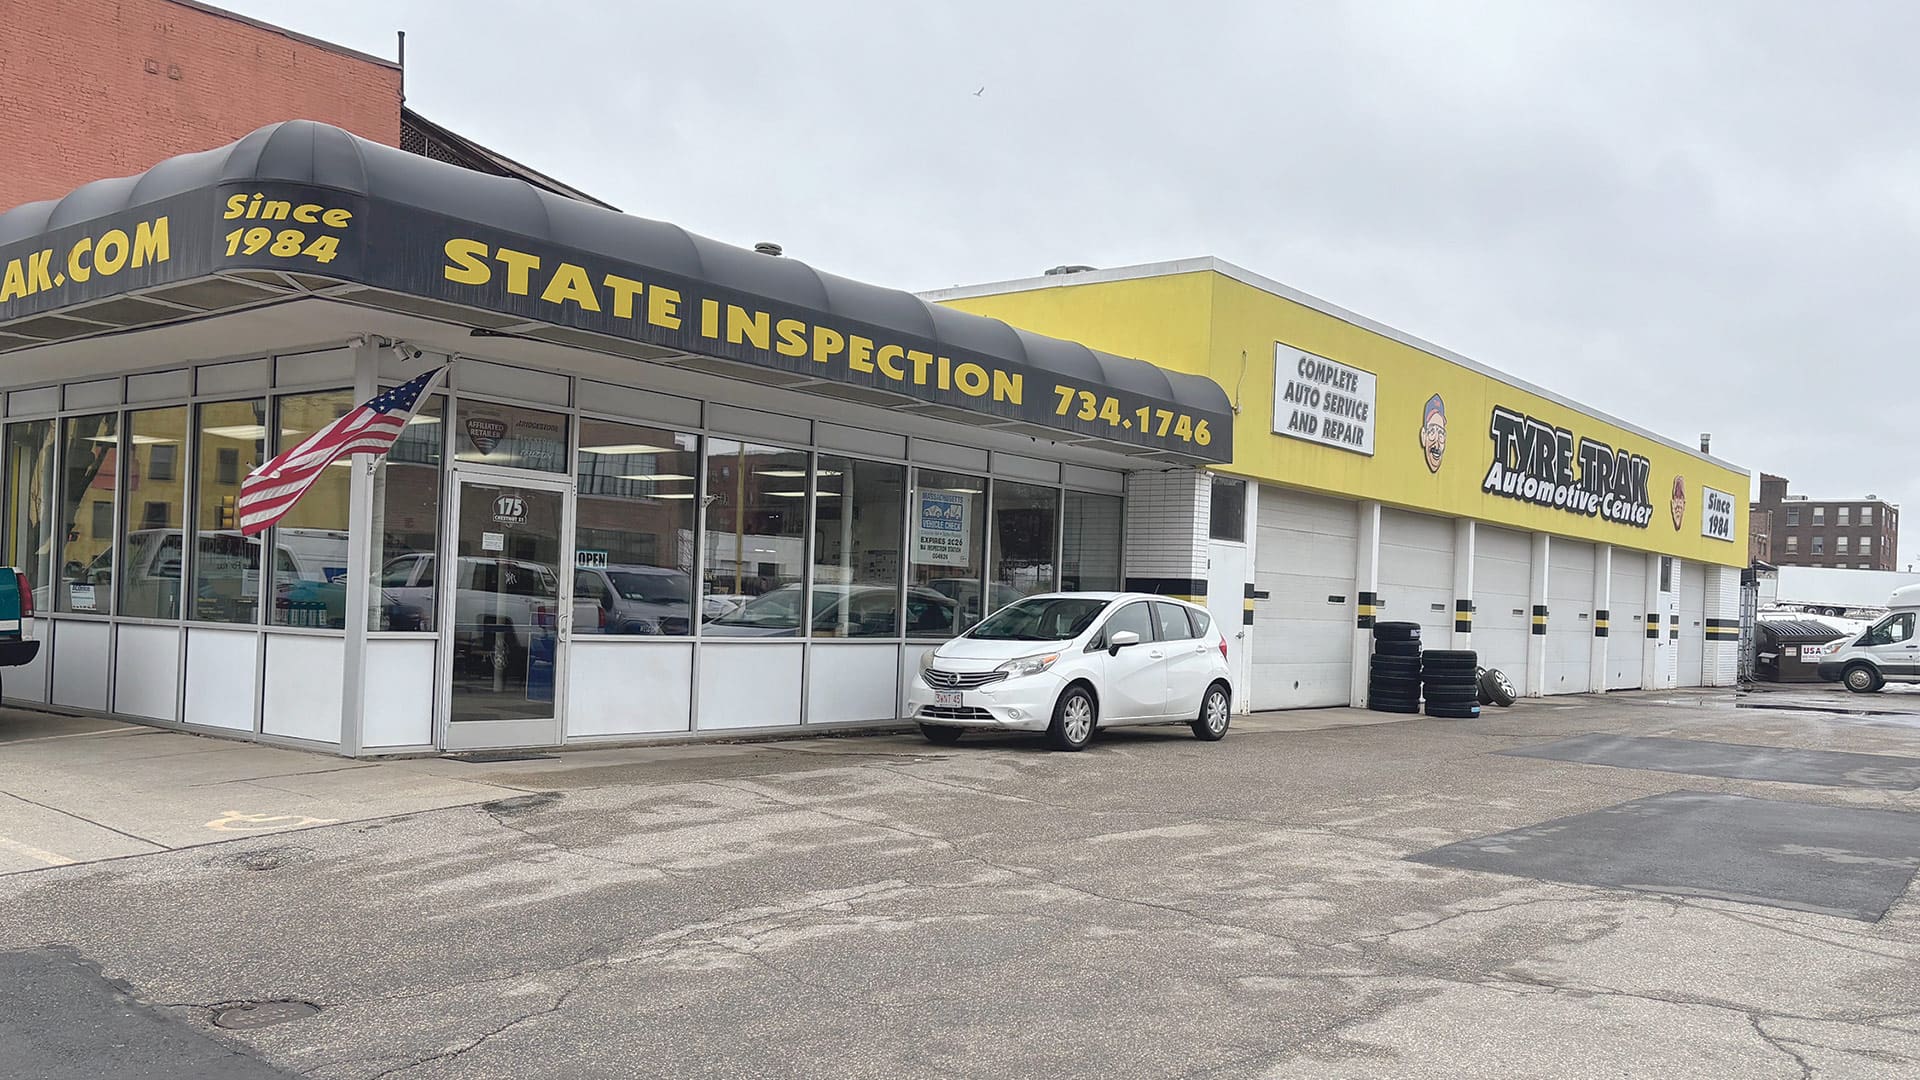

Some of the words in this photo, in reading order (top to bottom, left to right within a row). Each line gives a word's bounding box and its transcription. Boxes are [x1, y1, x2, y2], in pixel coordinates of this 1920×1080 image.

[223, 193, 353, 228] Since
[225, 226, 341, 264] 1984
[443, 237, 682, 330] STATE
[701, 300, 1024, 406] INSPECTION
[1054, 384, 1212, 446] 734.1746
[1297, 357, 1359, 393] COMPLETE
[1283, 380, 1320, 408] AUTO
[1322, 390, 1369, 422] SERVICE
[468, 421, 504, 431] AFFILIATED
[470, 429, 502, 438] RETAILER
[1288, 409, 1318, 434] AND
[1321, 417, 1364, 446] REPAIR
[1490, 406, 1574, 487] TYRE
[1579, 437, 1651, 505] TRAK
[498, 498, 522, 516] 175
[1483, 461, 1601, 514] Automotive
[1602, 492, 1653, 527] Center
[1708, 493, 1731, 515] Since
[923, 520, 944, 529] VEHICLE
[944, 522, 961, 530] CHECK
[1709, 514, 1729, 537] 1984
[920, 536, 946, 545] EXPIRES
[578, 552, 606, 567] OPEN
